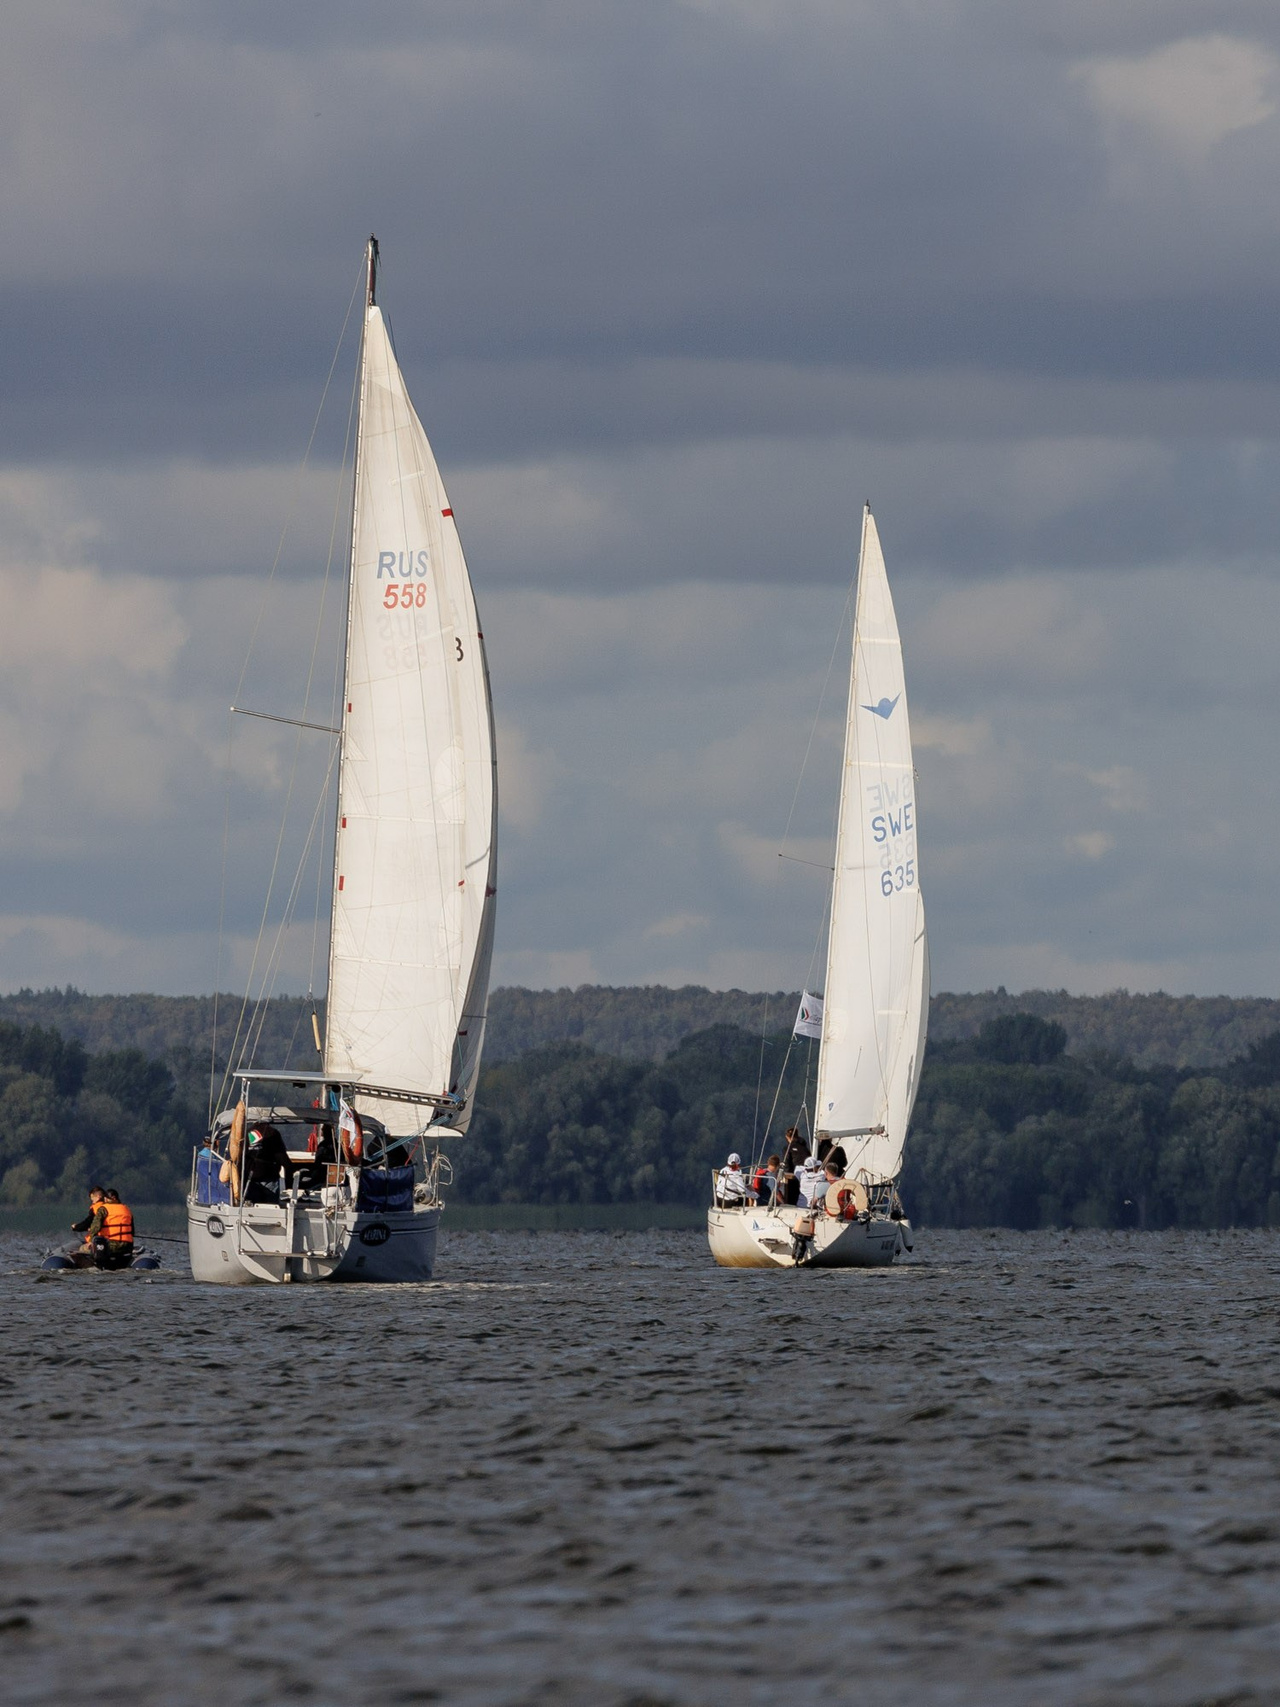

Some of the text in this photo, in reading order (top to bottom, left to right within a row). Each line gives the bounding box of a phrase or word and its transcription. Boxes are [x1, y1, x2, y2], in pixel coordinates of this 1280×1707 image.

[376, 550, 430, 579] RUS
[382, 582, 427, 610] 558
[871, 802, 914, 843] SWE
[880, 859, 915, 897] 635
